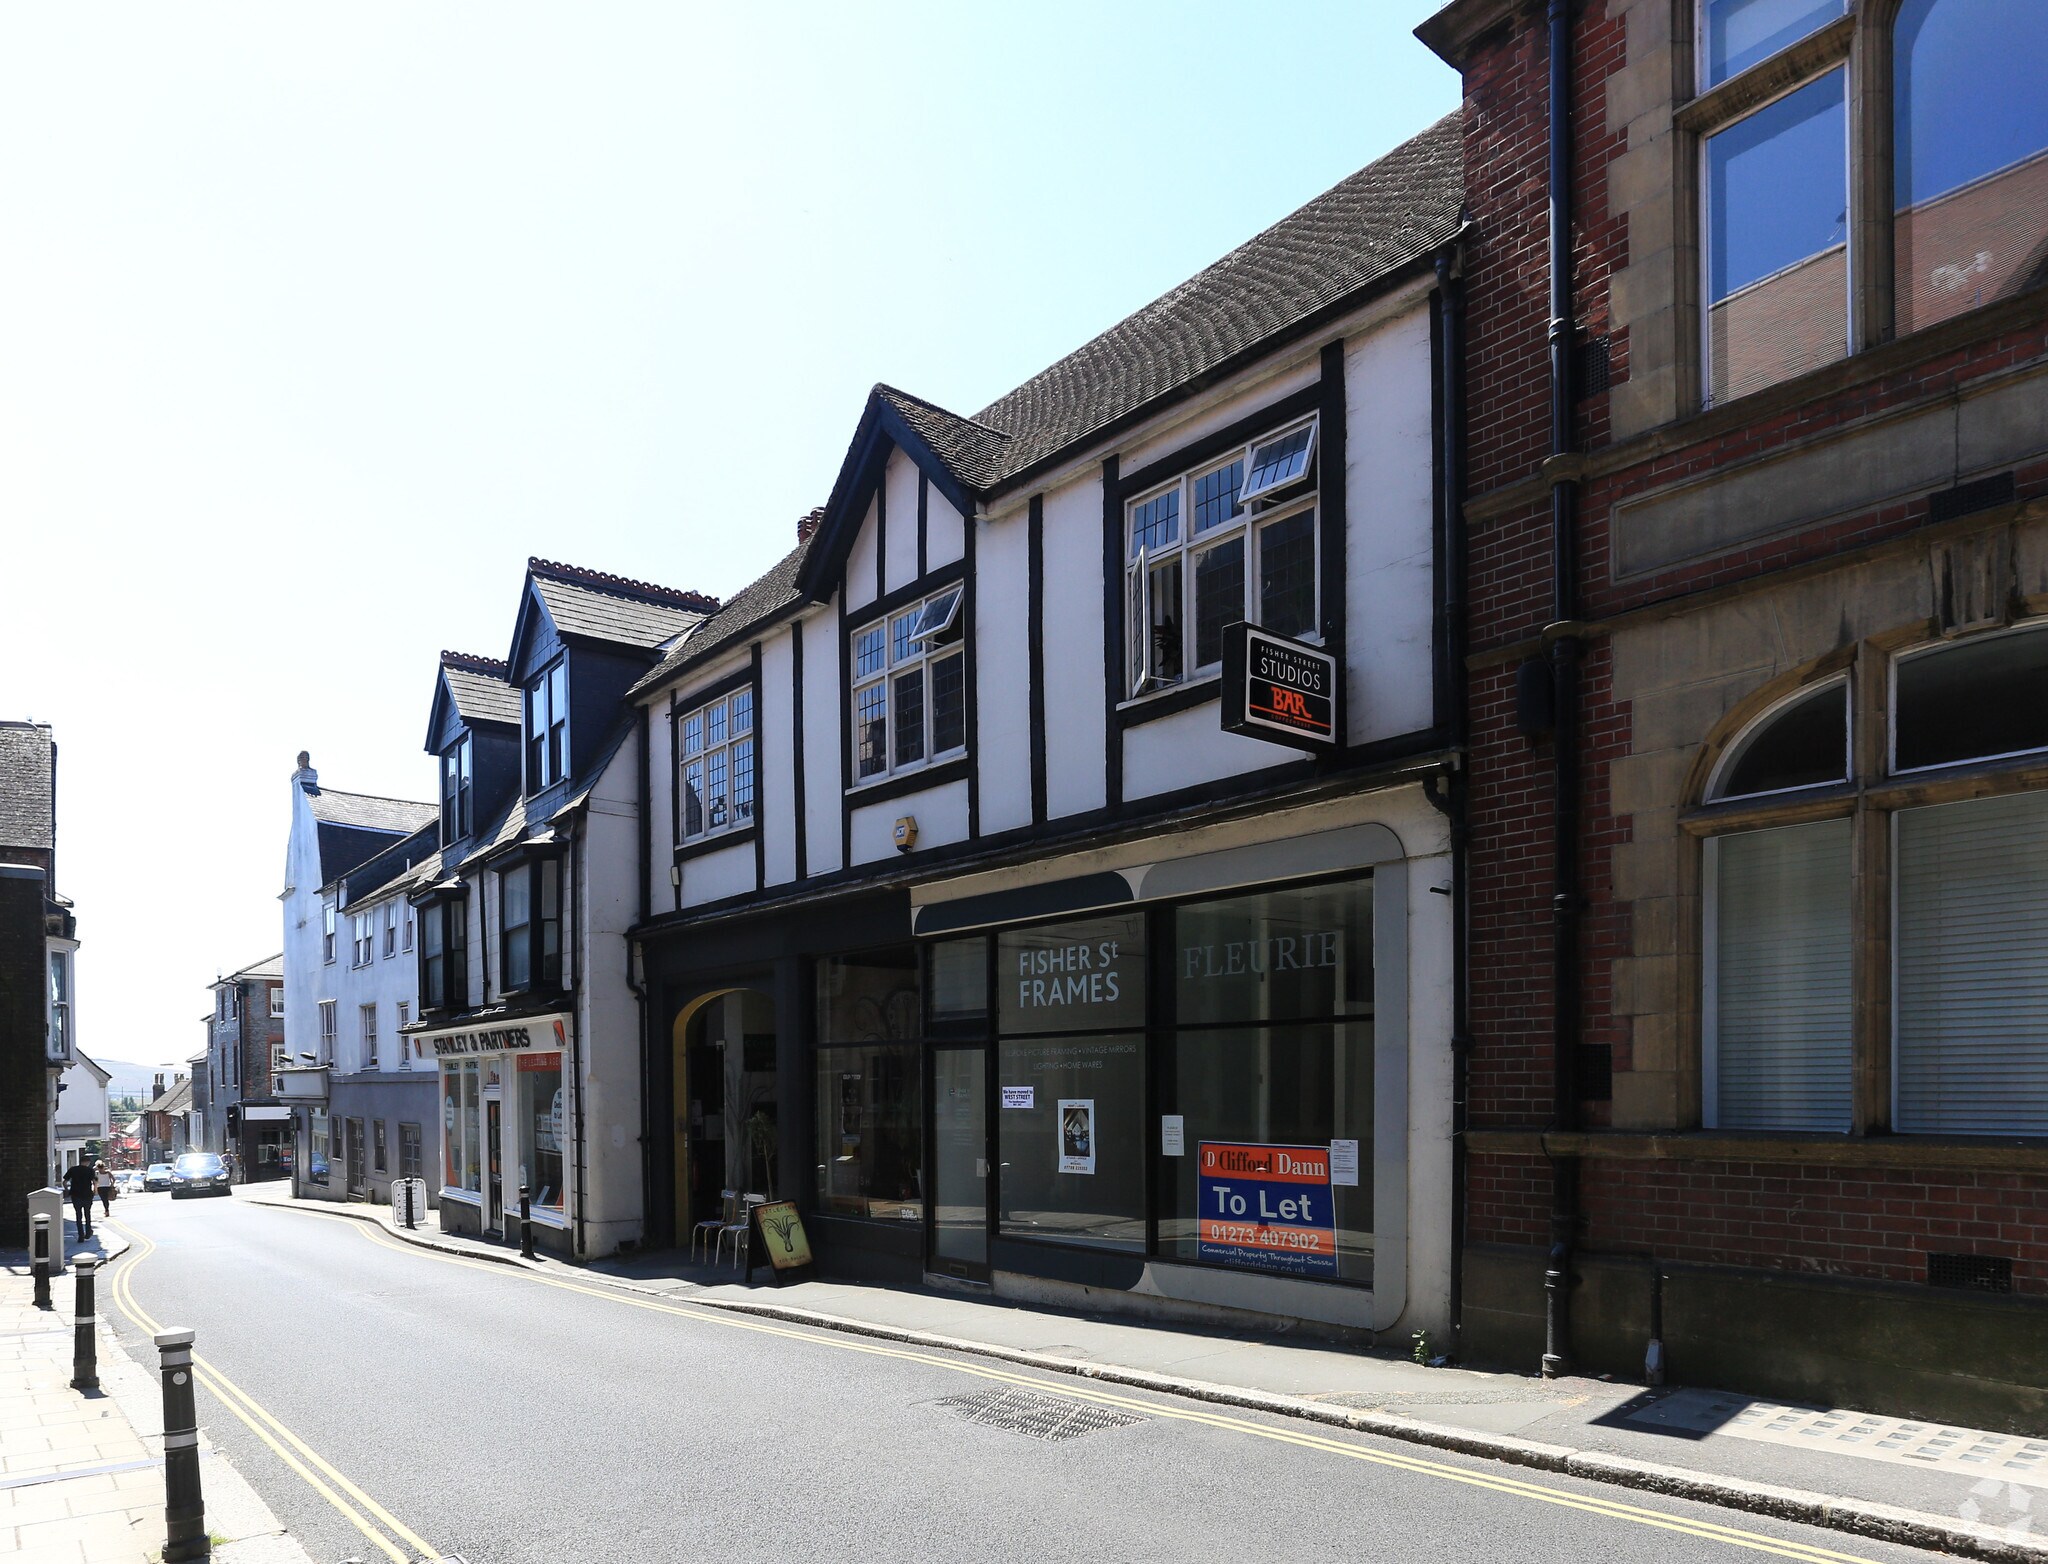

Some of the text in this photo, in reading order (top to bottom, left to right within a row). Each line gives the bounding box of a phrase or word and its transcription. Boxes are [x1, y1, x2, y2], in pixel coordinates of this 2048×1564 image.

[1261, 646, 1320, 670] FISHER STREET
[1261, 657, 1320, 690] STUDIOS
[1270, 686, 1312, 719] BAR
[1020, 940, 1119, 976] FISHER St
[1184, 930, 1339, 979] FLEURIE
[1020, 972, 1119, 1008] FRAMES
[433, 1027, 531, 1055] STANLEY & PARTNERS
[1050, 1047, 1078, 1056] FRAMING
[1081, 1046, 1108, 1055] VINTAGE
[1108, 1044, 1137, 1053] MIRRORS
[1062, 1061, 1081, 1070] HOME
[1082, 1060, 1103, 1069] WARES
[1219, 1150, 1273, 1174] Clifford
[1277, 1153, 1326, 1177] Dann
[1212, 1186, 1313, 1222] To Let
[1211, 1224, 1320, 1250] 01273 407902
[1202, 1244, 1334, 1267] Commercial Property Throughout Sussex
[1223, 1257, 1307, 1274] clifforddanncouk
